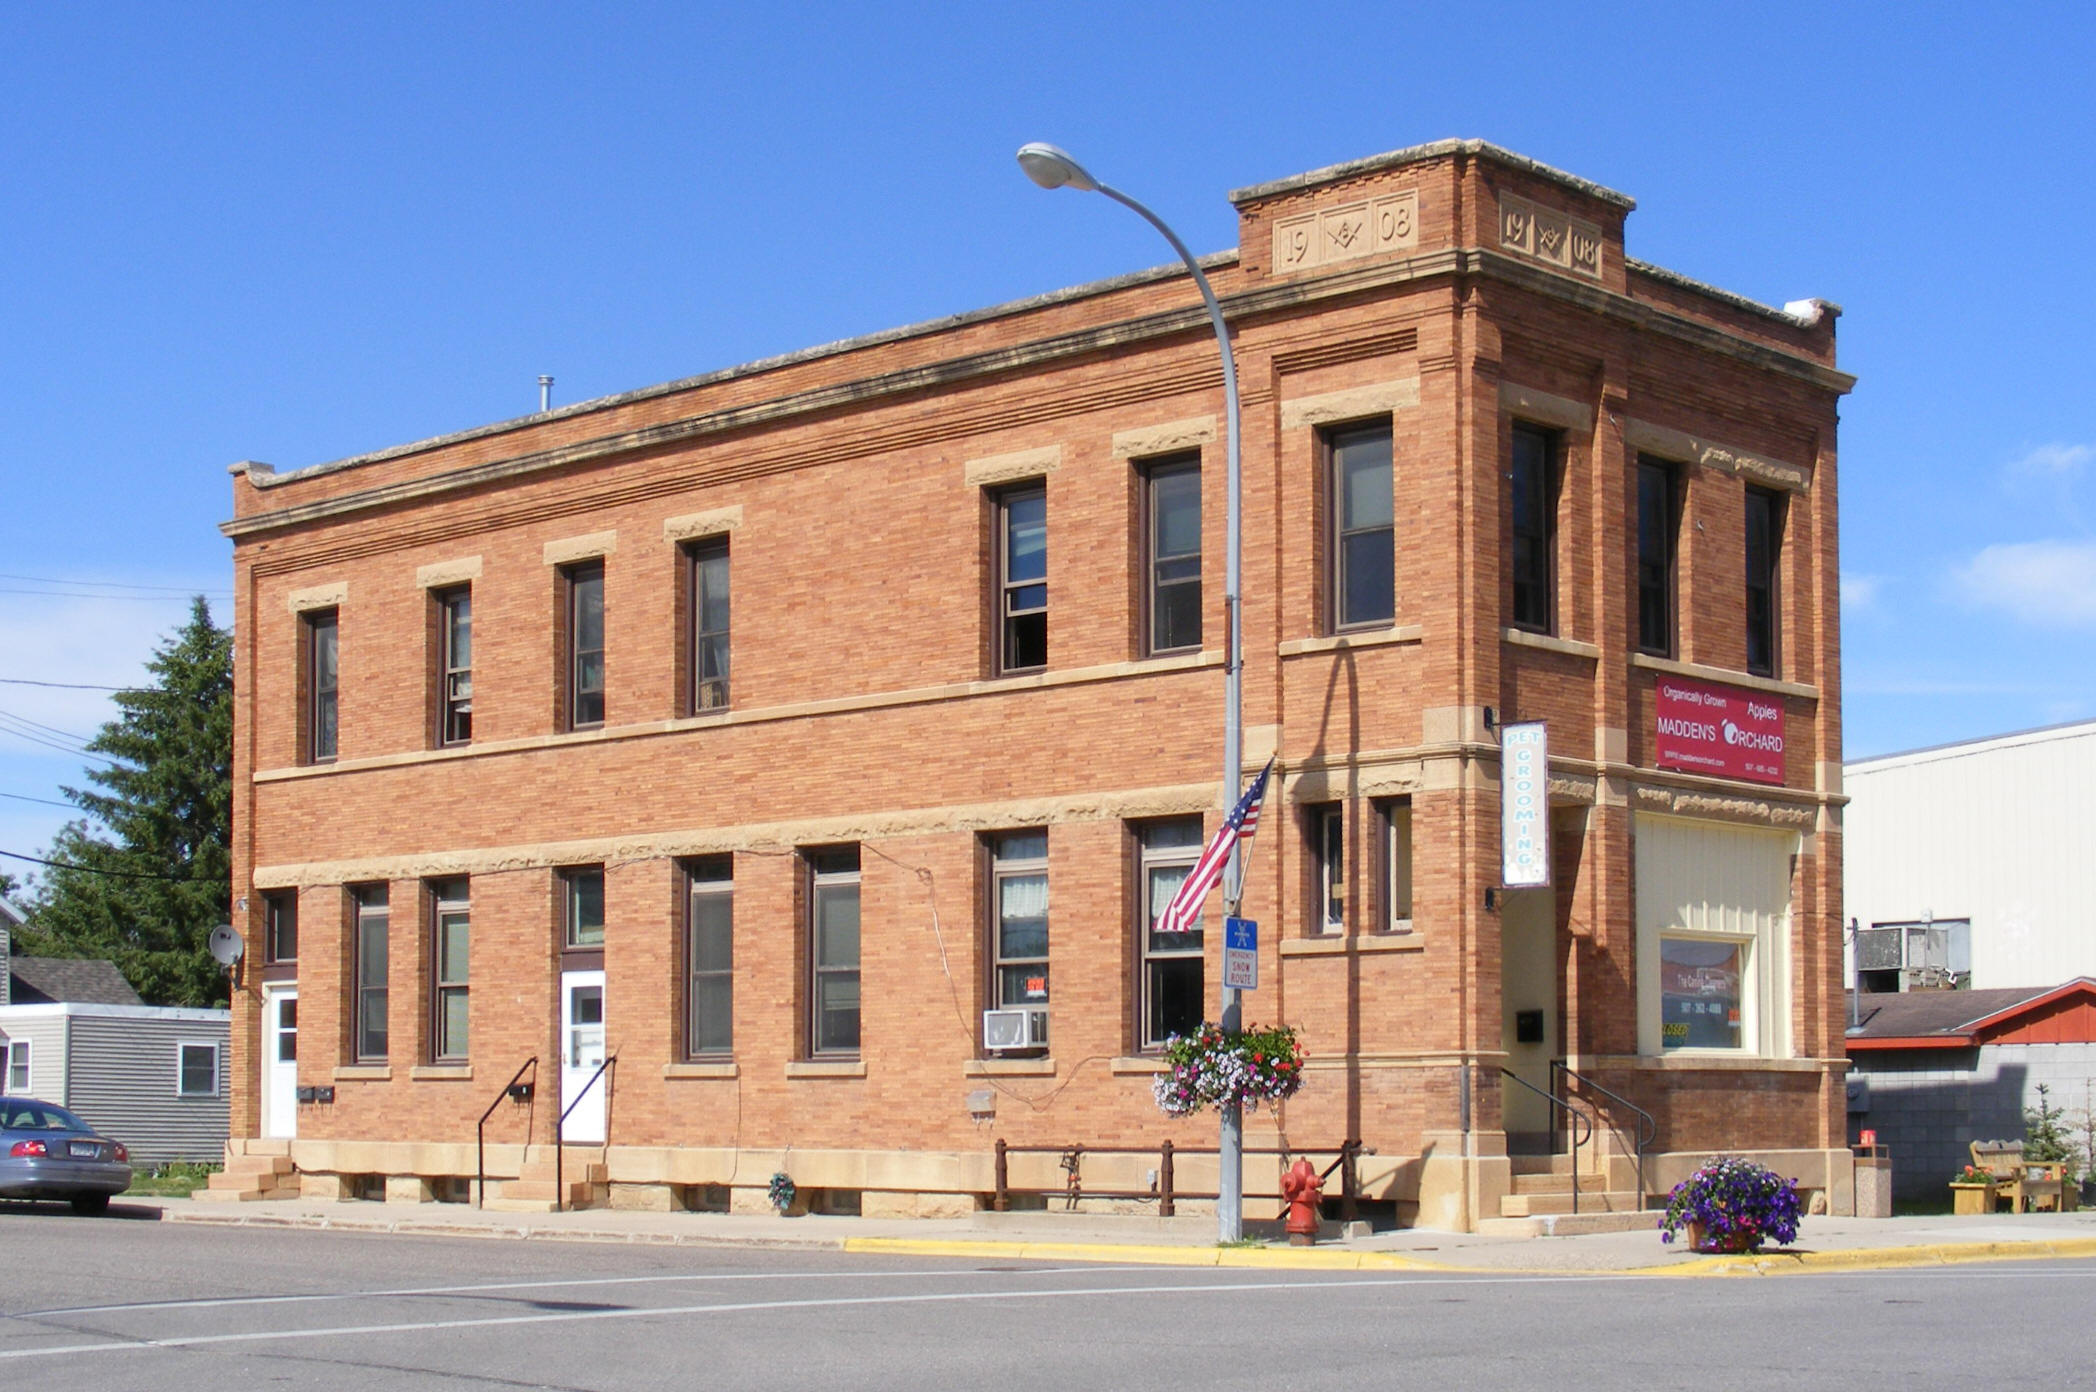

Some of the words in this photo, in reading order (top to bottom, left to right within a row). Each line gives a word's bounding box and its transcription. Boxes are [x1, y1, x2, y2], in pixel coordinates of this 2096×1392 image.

[1287, 230, 1309, 263] 19
[1381, 208, 1412, 241] 08
[1505, 212, 1524, 242] 19
[1573, 234, 1595, 265] 08
[1663, 685, 1703, 706] Organically
[1704, 693, 1727, 708] Grown
[1747, 702, 1777, 721] Apples
[1507, 731, 1540, 746] PET
[1658, 717, 1716, 742] MADDEN'S
[1723, 721, 1783, 753] ORCHARD
[1515, 750, 1534, 865] GROOMING
[1232, 961, 1250, 972] SNOW
[1230, 973, 1252, 985] ROUTE
